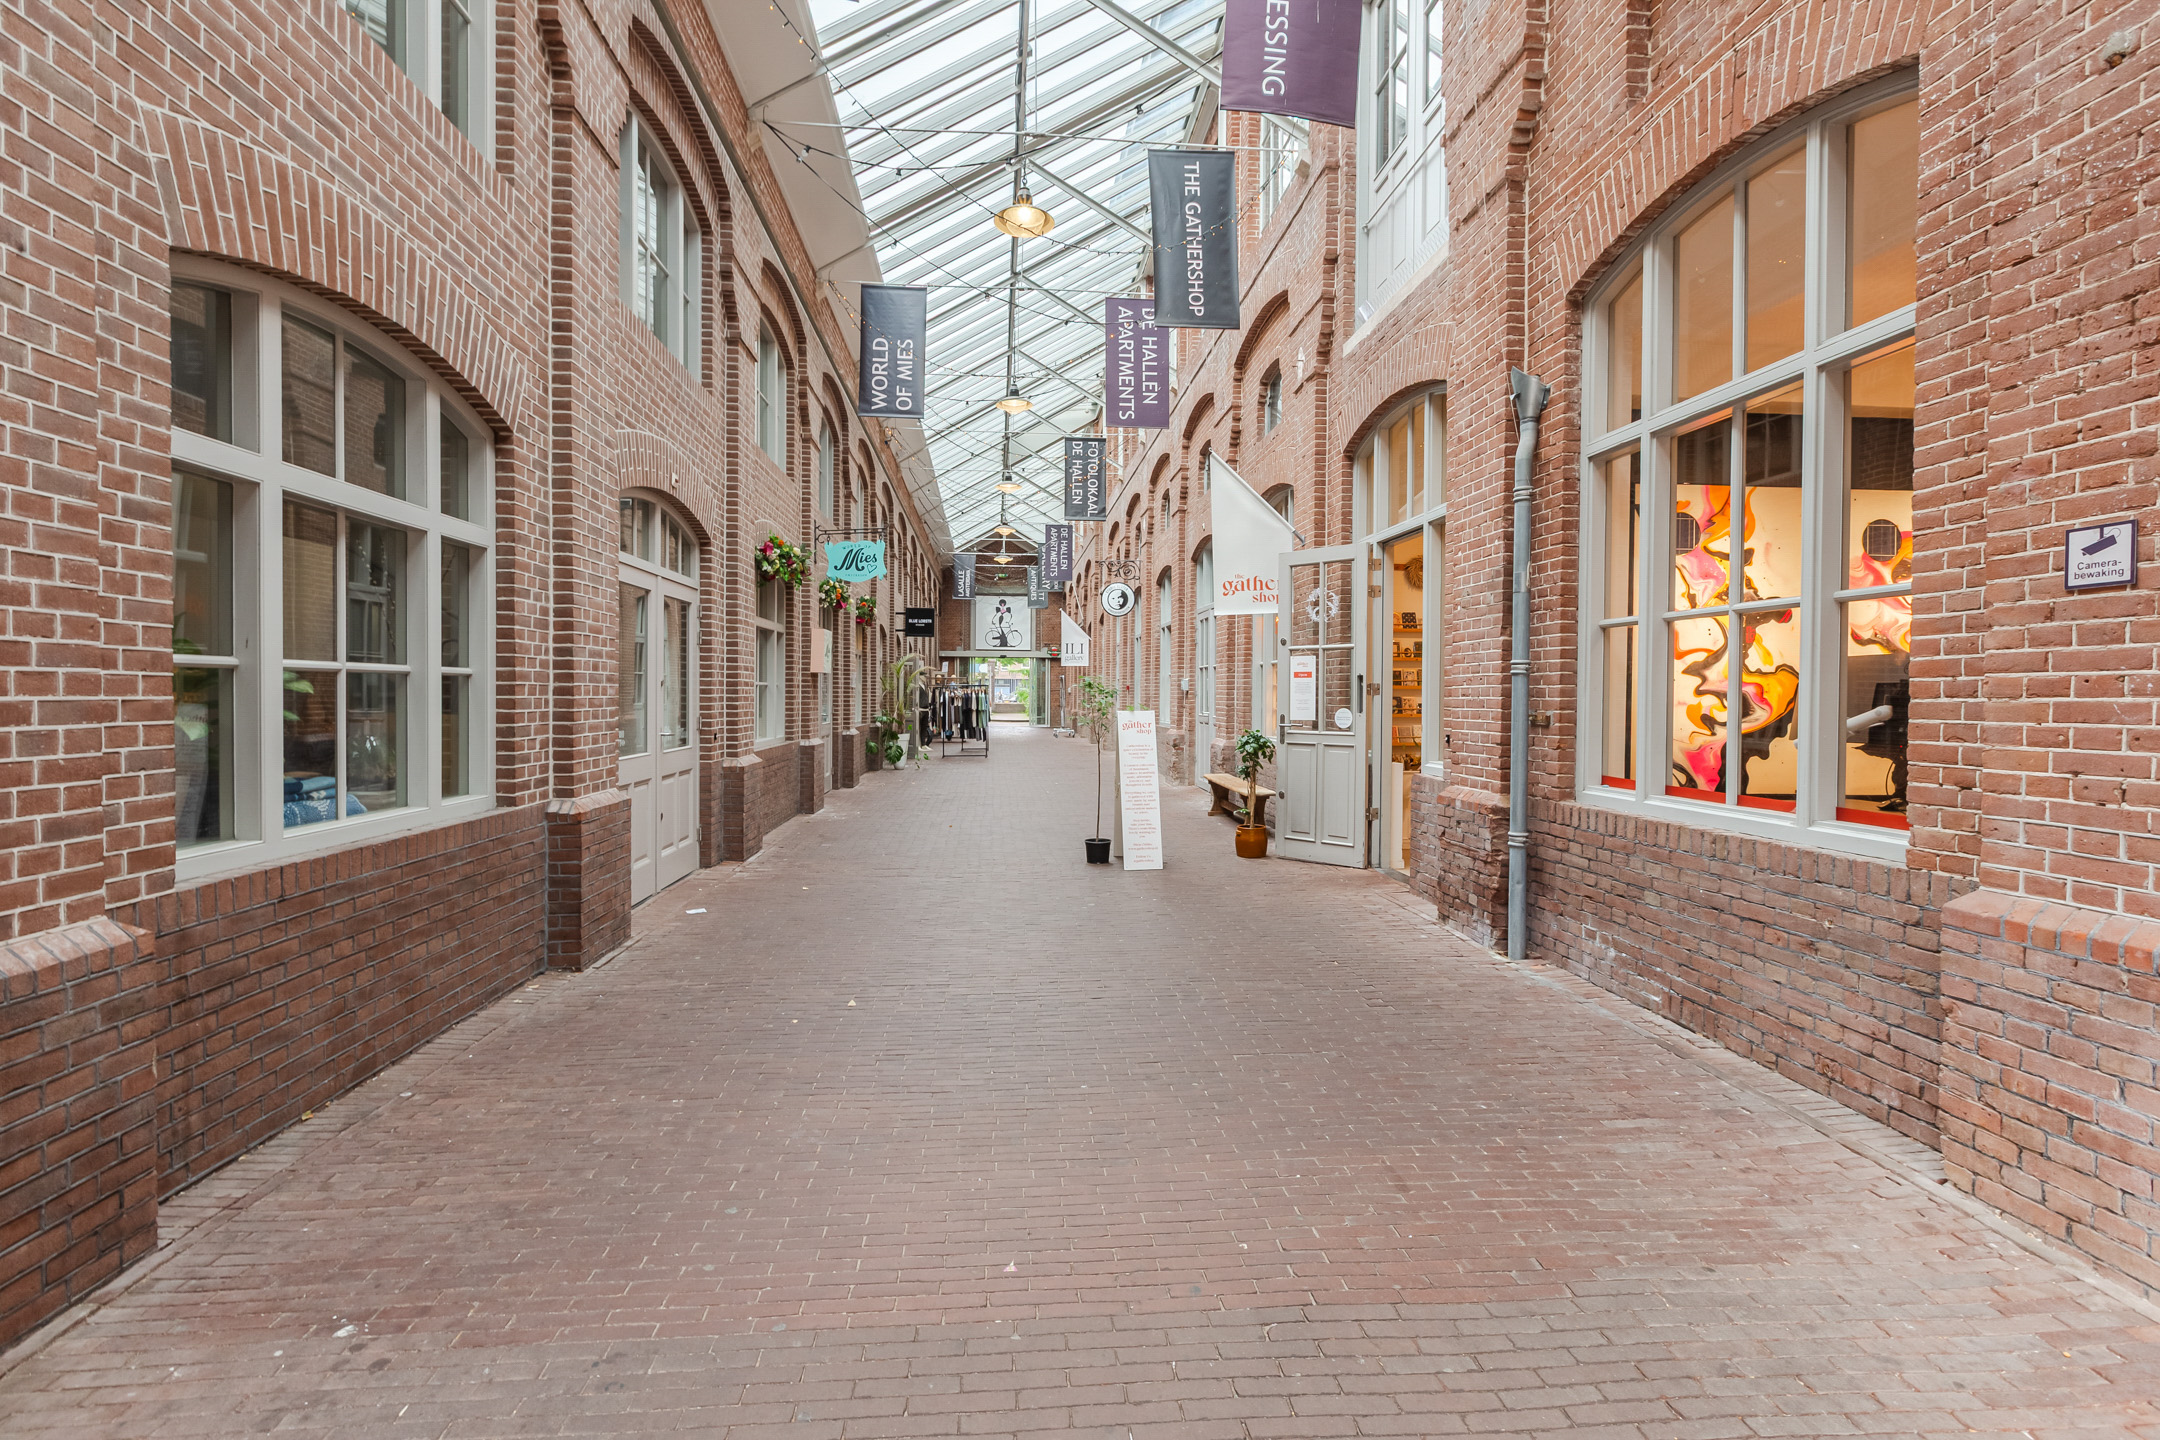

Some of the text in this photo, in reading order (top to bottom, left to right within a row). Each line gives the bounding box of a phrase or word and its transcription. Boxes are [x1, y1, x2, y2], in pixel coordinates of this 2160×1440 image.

[1184, 161, 1204, 316] THE GATHERSHOP
[871, 337, 888, 410] WORLD
[895, 339, 913, 411] OF MIES
[1118, 306, 1134, 420] APARTMENTS
[1142, 308, 1158, 404] DE HALLEN
[1072, 442, 1083, 505] DE HALLEN
[1088, 442, 1098, 517] FOTOLOKAAL
[834, 548, 877, 571] Mies
[1050, 528, 1058, 577] APARTMENTS
[1061, 528, 1068, 538] DE
[2074, 568, 2124, 580] bewaking
[2077, 560, 2122, 570] Camera-
[1122, 720, 1152, 731] gather
